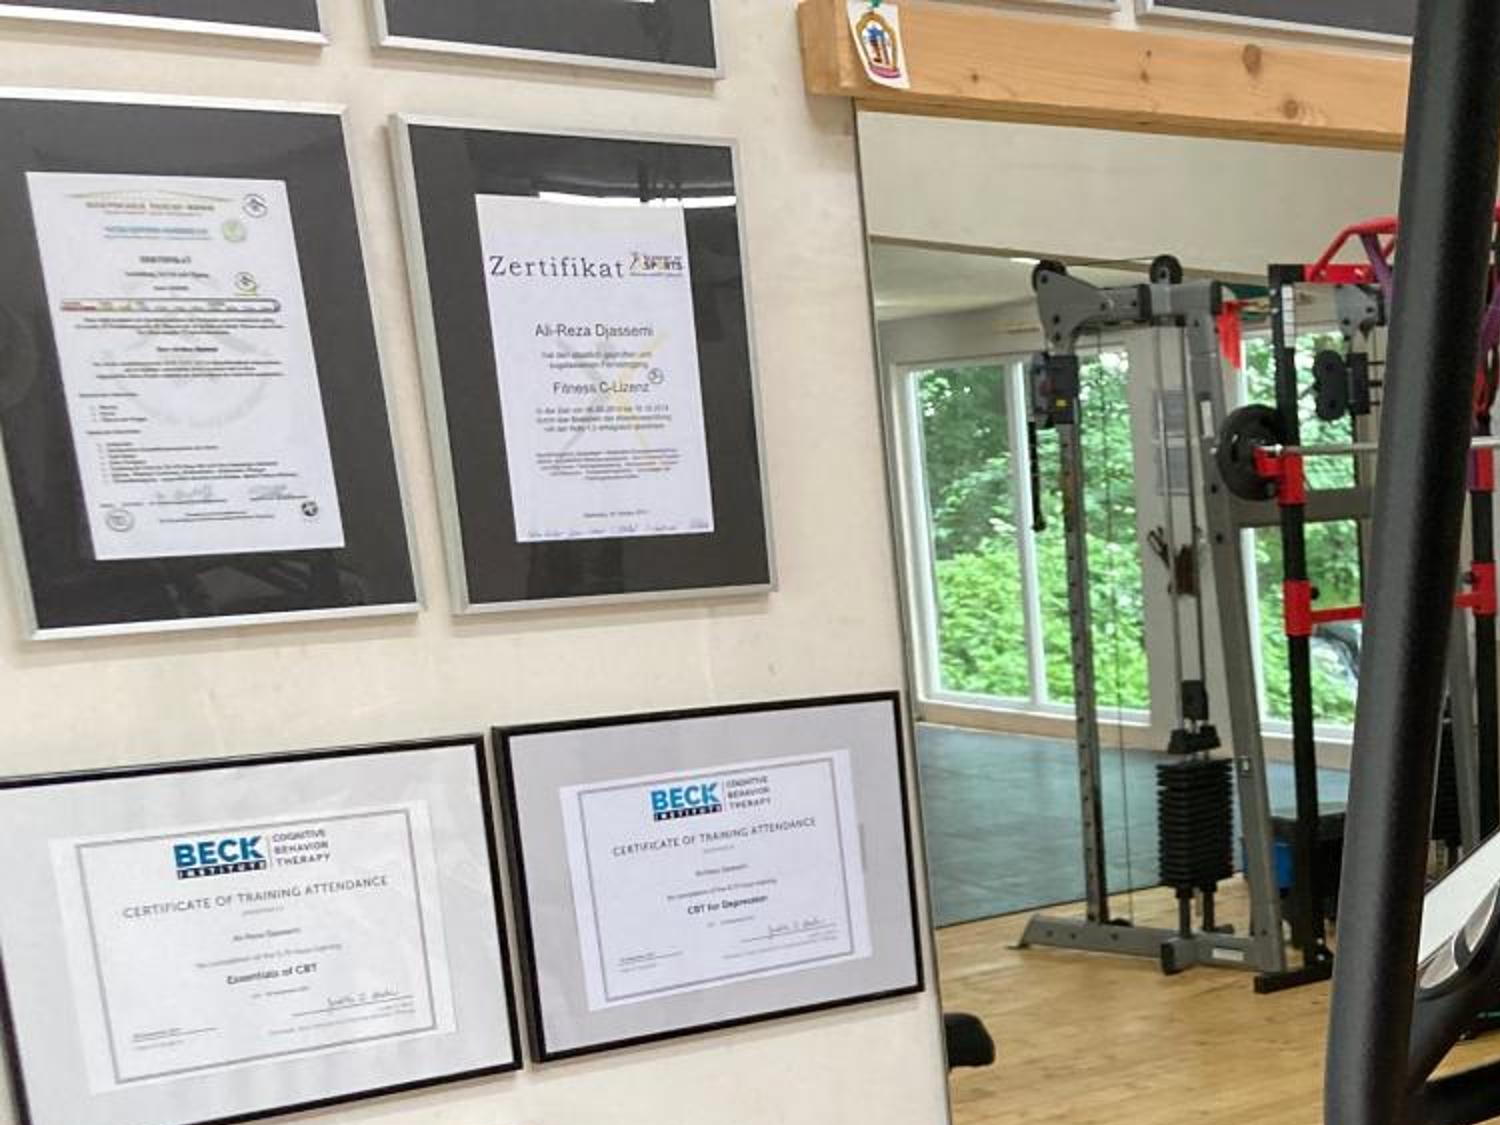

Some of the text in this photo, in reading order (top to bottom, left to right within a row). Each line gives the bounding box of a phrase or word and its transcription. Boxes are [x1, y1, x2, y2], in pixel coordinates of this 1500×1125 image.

[488, 255, 625, 280] Zertifikat
[595, 322, 655, 342] Djassemi
[651, 782, 720, 811] BECK
[728, 787, 771, 799] BEHAVIOR
[729, 798, 771, 810] THERAPY
[272, 829, 326, 843] COGNITIVE
[612, 817, 817, 858] CERTIFICATE OF TRAINING ATTENDANCE
[173, 835, 265, 868] BECK
[274, 841, 329, 855] BEHAVIOR
[276, 853, 331, 867] THERAPY
[122, 875, 388, 920] CERTIFICATE OF TRAINING ATTENDANCE
[687, 904, 706, 916] CBT
[226, 962, 319, 986] Essentials of CBT
